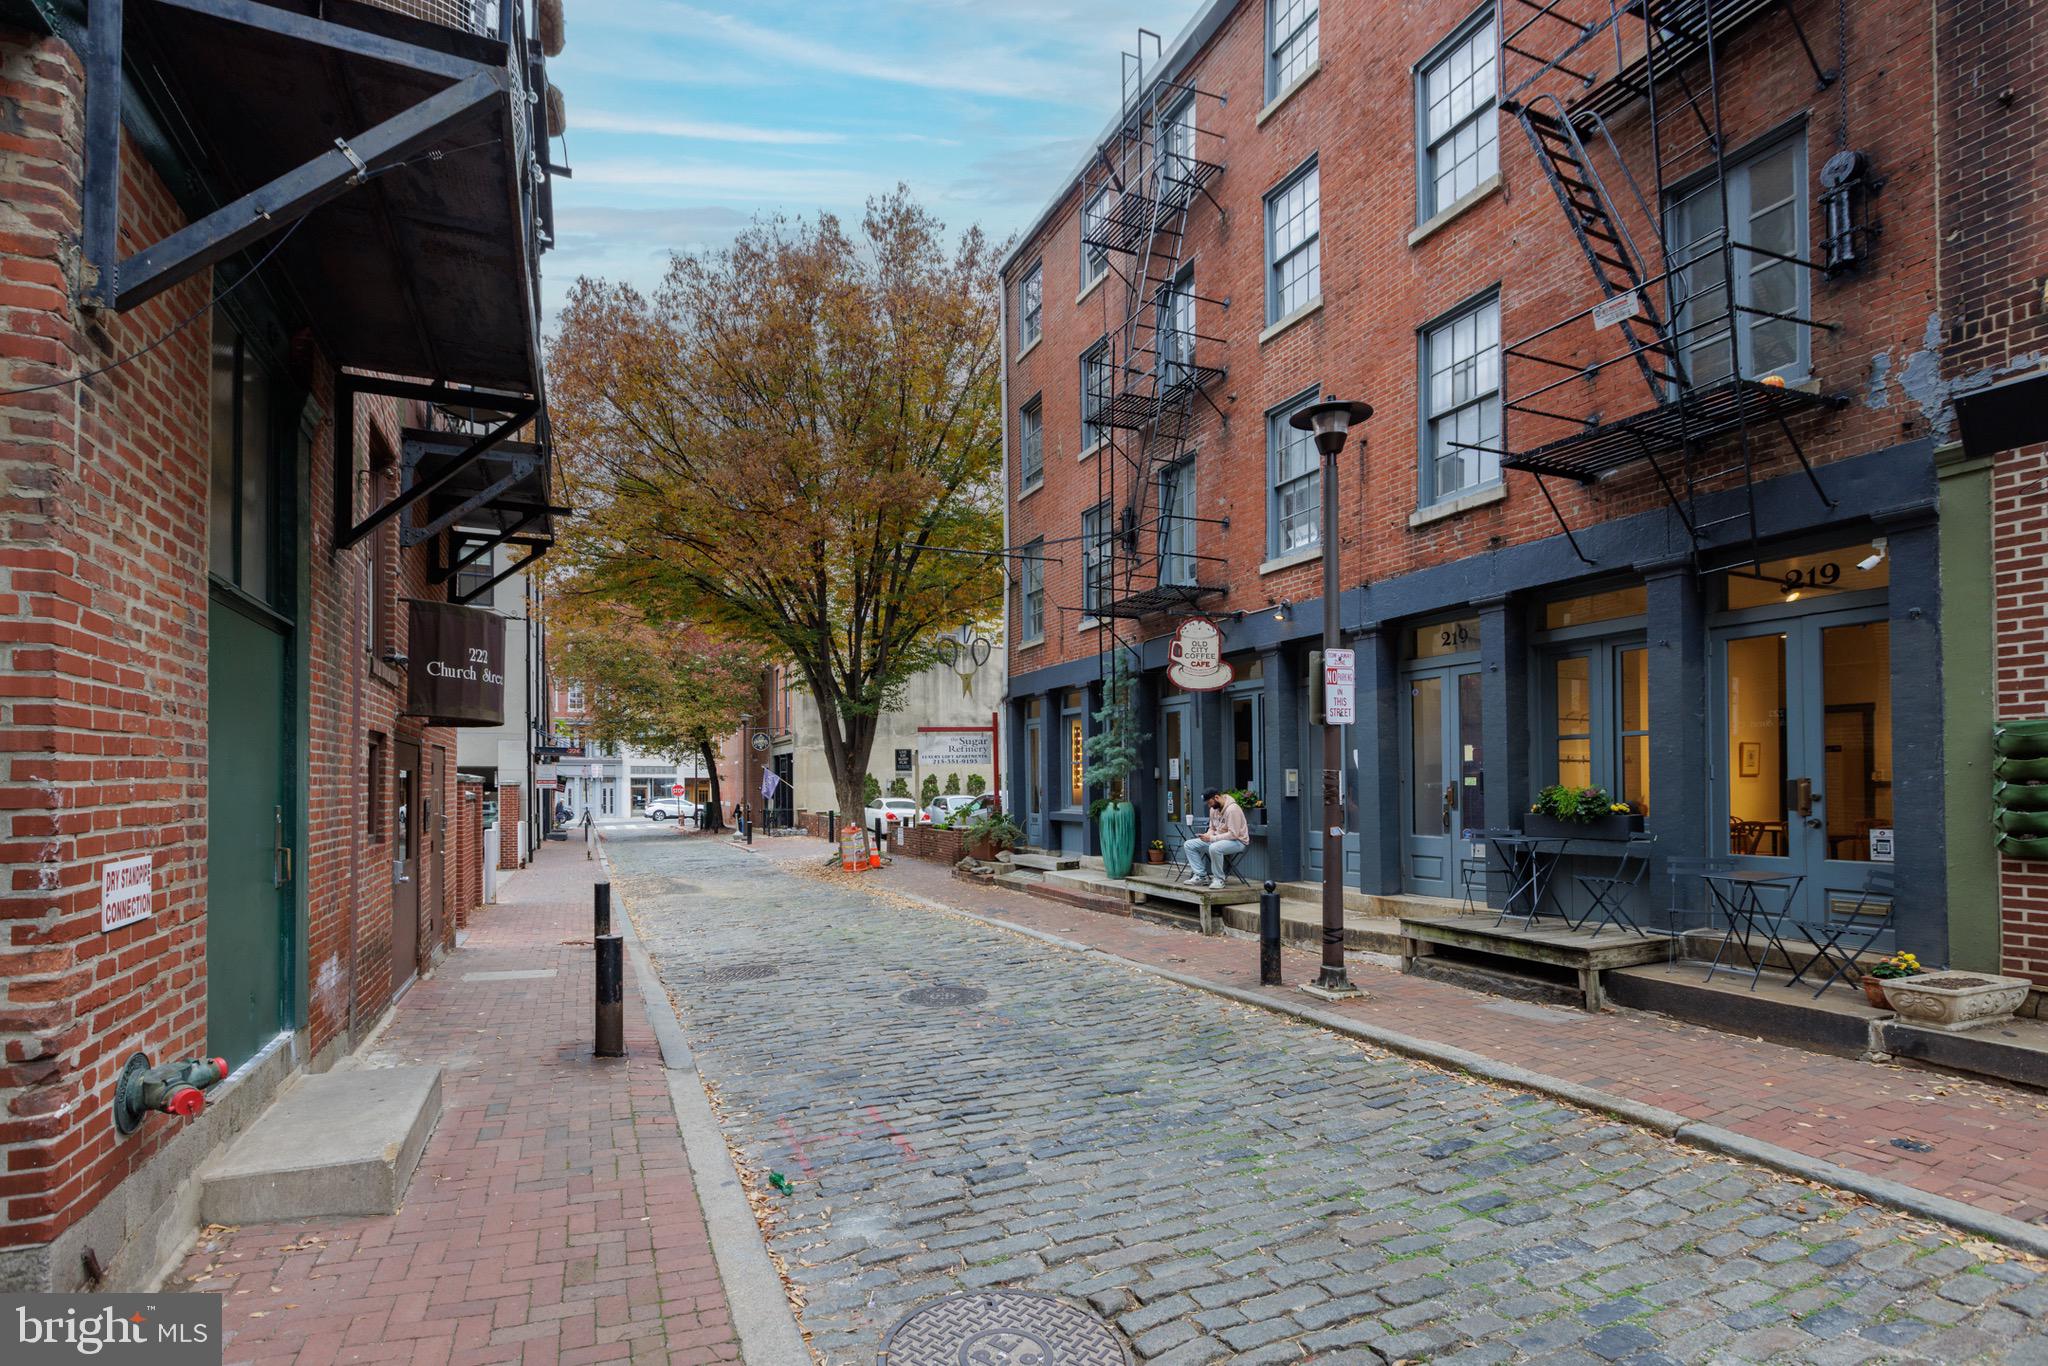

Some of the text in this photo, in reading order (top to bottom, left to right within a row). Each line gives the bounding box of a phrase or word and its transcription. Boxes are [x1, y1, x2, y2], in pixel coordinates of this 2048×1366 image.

[1785, 563, 1840, 588] 219
[1441, 628, 1468, 647] 219
[469, 647, 488, 664] 222
[427, 661, 477, 681] Church
[1327, 670, 1337, 684] NO
[1337, 688, 1343, 696] IN
[1334, 697, 1347, 706] THIS
[1330, 708, 1351, 717] STREET
[948, 745, 988, 754] Refinery
[960, 737, 988, 747] Sugar
[106, 863, 151, 892] DRY STANDPIPE
[106, 893, 151, 924] CONNECTION
